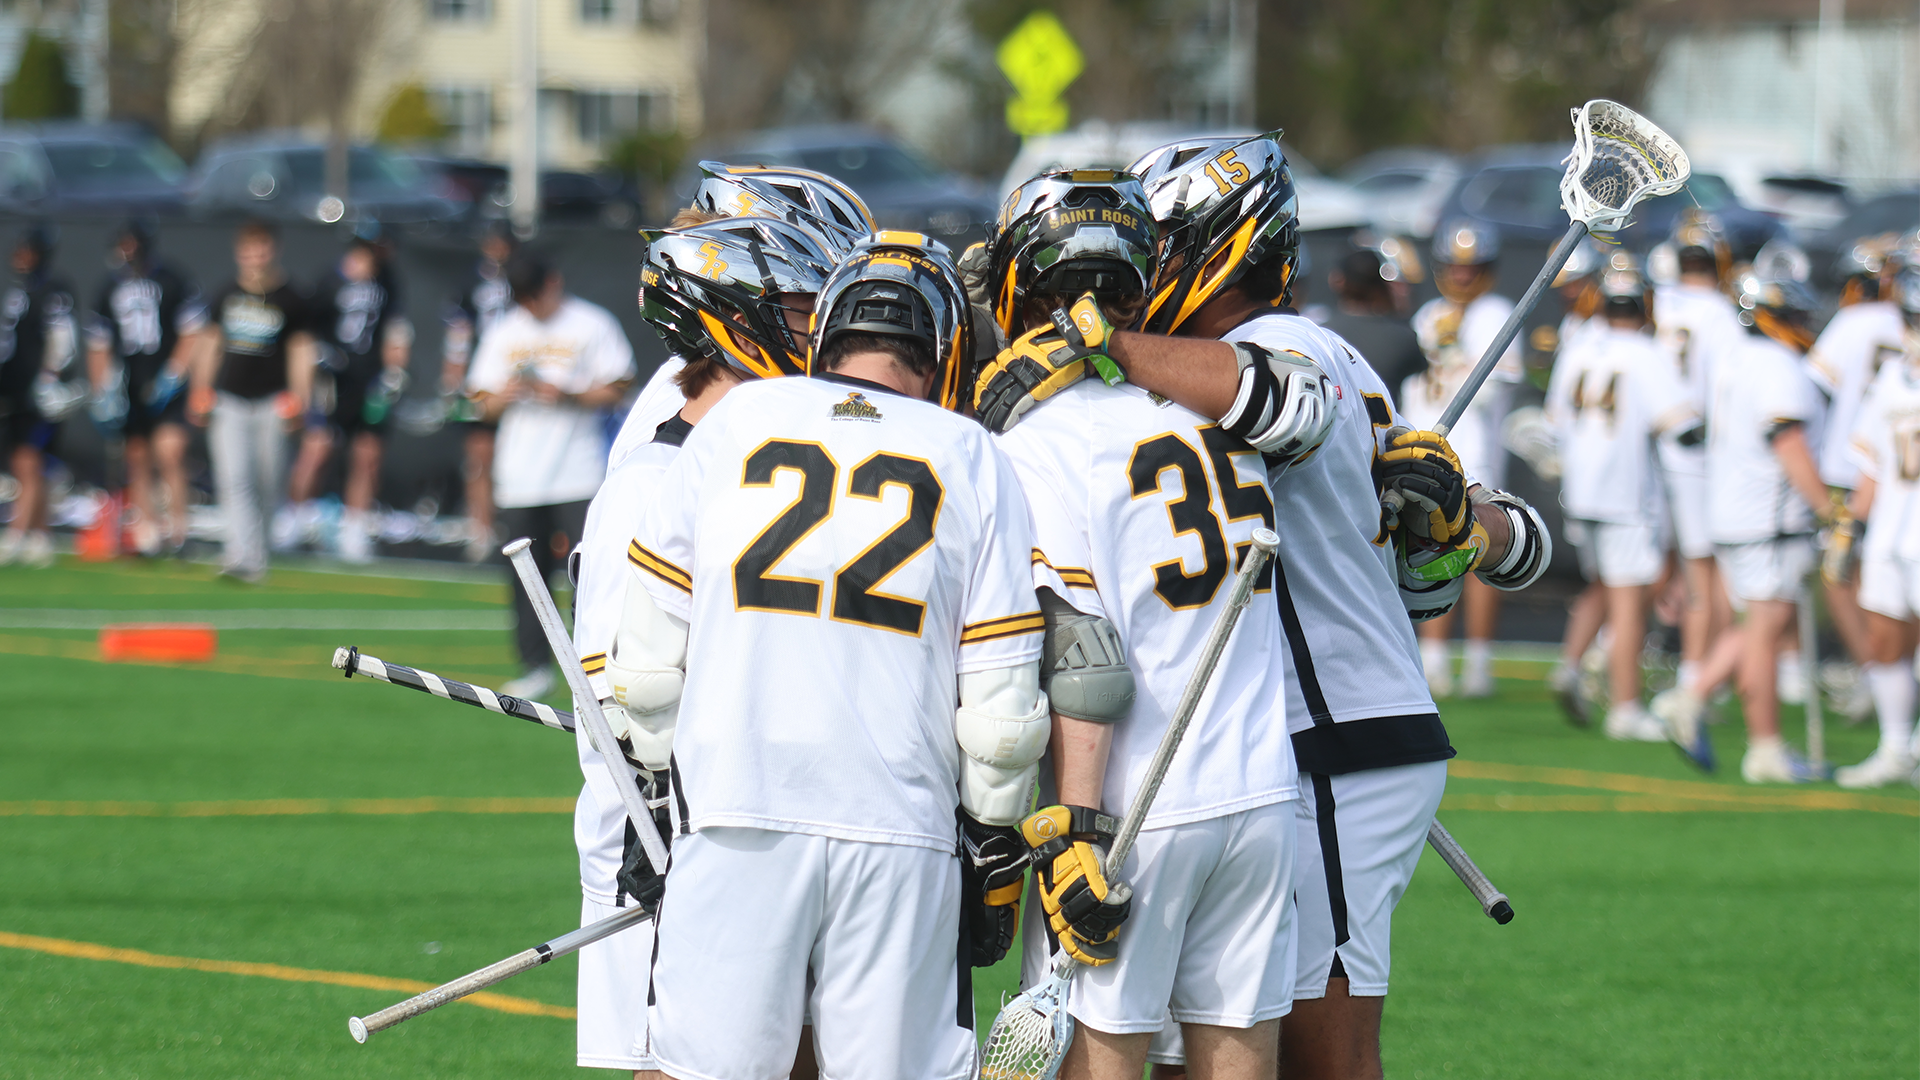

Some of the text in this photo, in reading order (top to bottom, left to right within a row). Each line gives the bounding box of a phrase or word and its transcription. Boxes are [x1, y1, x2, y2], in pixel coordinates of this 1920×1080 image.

[1204, 149, 1250, 197] 15
[1049, 208, 1138, 231] SAINT ROSE
[694, 241, 729, 281] SR
[847, 252, 940, 275] SAINT ROSE
[731, 437, 946, 638] 22
[1126, 423, 1276, 612] 35
